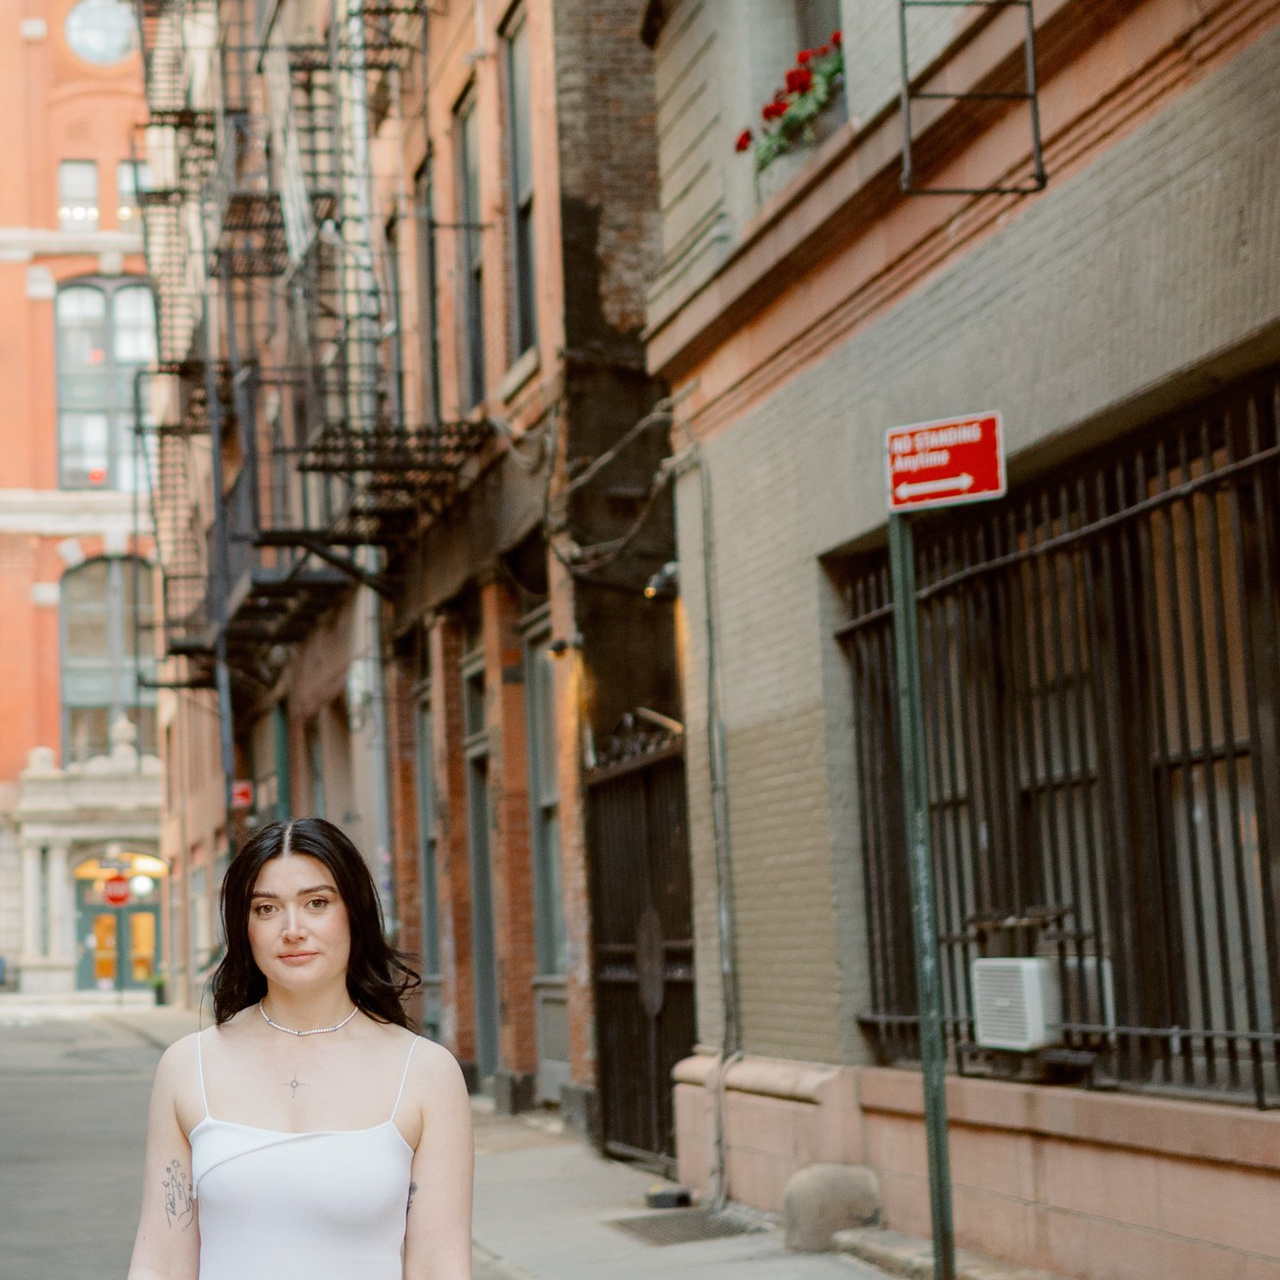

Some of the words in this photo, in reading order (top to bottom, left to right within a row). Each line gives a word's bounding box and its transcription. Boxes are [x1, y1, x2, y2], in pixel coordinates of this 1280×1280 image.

[892, 434, 912, 454] NO
[914, 422, 982, 451] STANDING
[894, 449, 950, 472] Anytime
